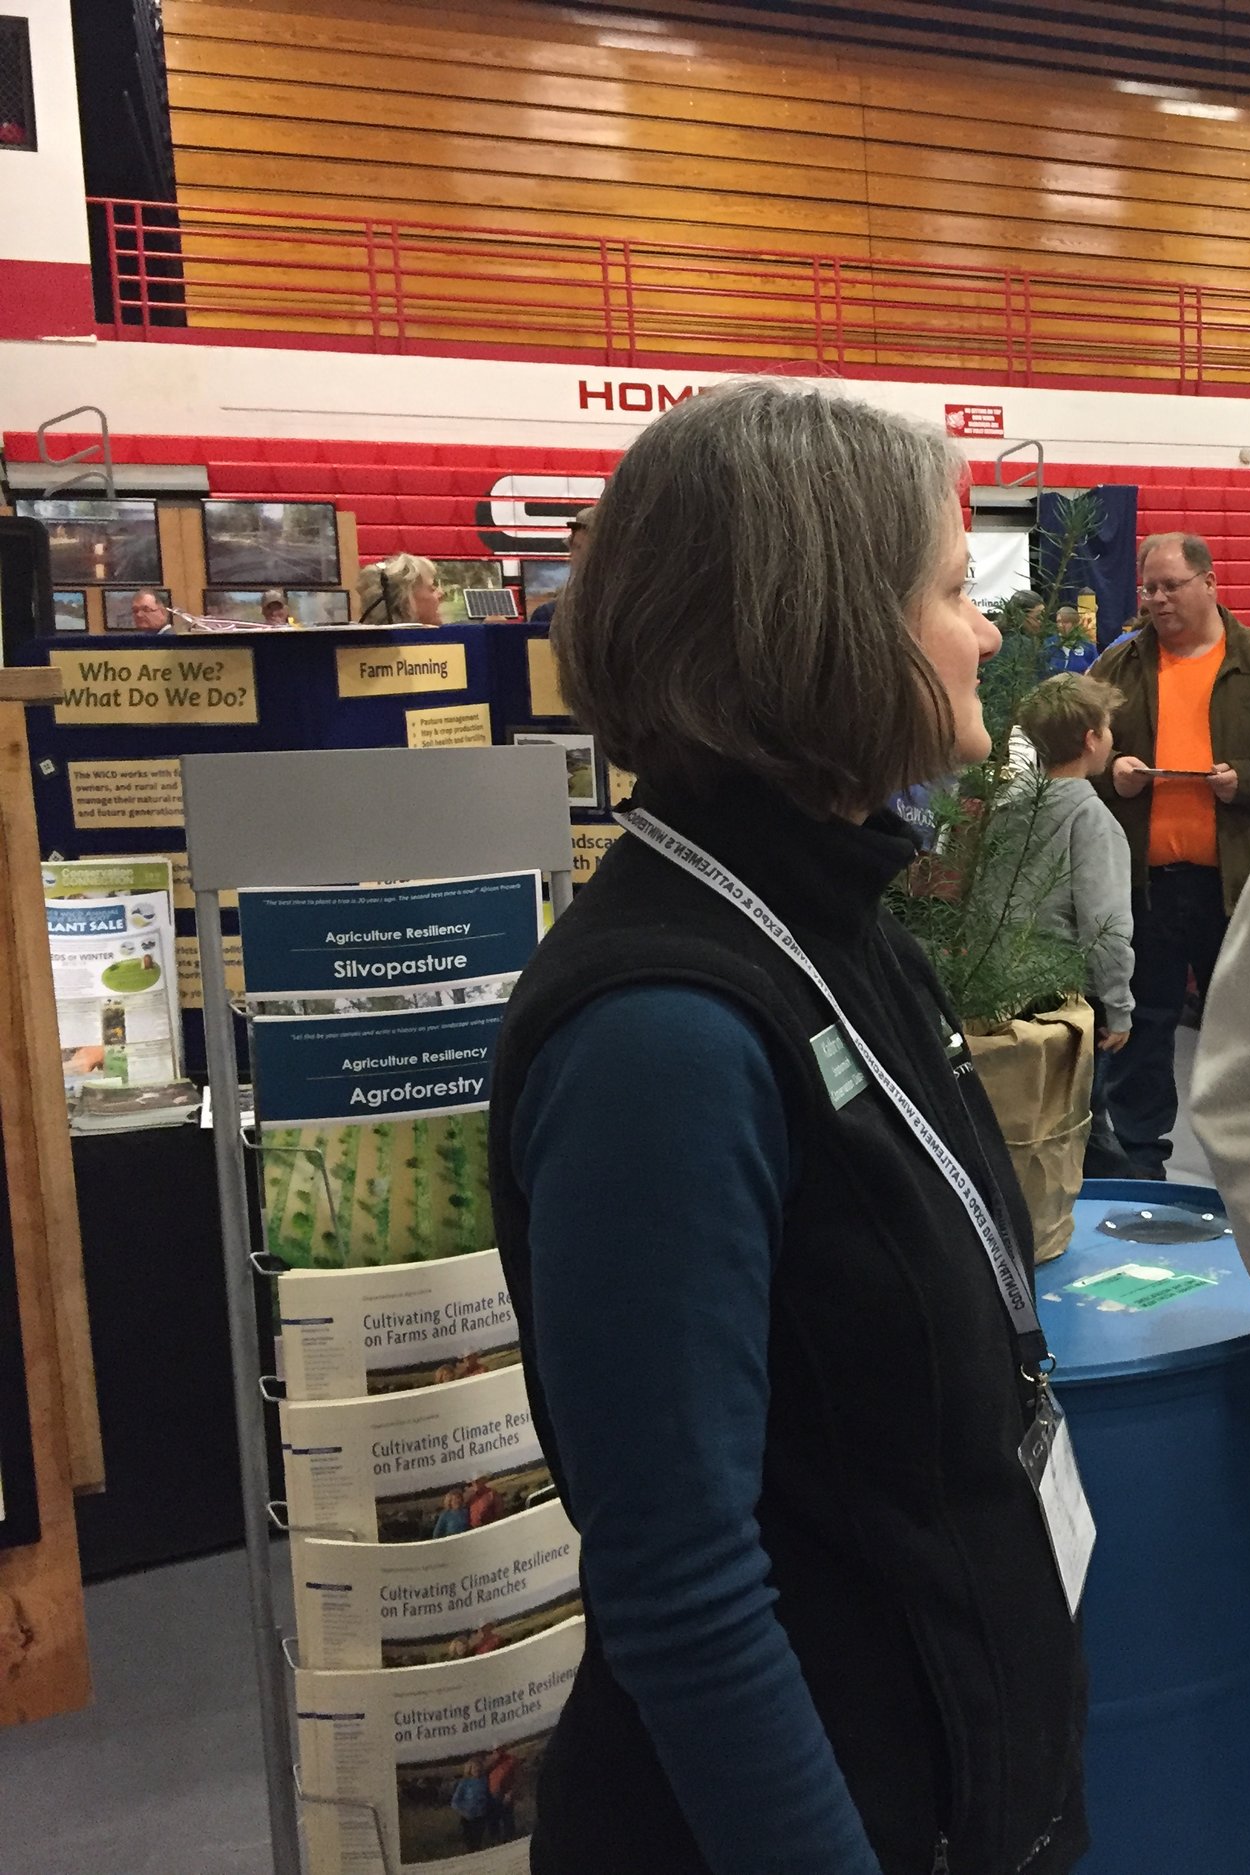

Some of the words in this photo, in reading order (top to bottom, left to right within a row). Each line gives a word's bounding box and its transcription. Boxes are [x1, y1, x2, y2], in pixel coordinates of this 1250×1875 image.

[578, 380, 708, 412] HOM
[78, 661, 132, 682] Who
[136, 664, 172, 682] Are
[177, 661, 225, 682] We?
[360, 661, 393, 679] Farm
[396, 658, 448, 679] Planning
[64, 687, 122, 708] What
[128, 687, 159, 708] Do
[165, 687, 202, 708] We
[207, 686, 247, 708] Do?
[89, 919, 124, 931] SALE
[325, 930, 402, 946] Agriculture
[406, 922, 471, 939] Resiliency
[79, 951, 114, 960] WINTER
[334, 952, 468, 979] Silvopasture
[342, 1054, 418, 1072] Agriculture
[422, 1046, 488, 1064] Resiliency
[350, 1076, 484, 1107] Agroforestry
[363, 1309, 440, 1330] Cultivating
[445, 1297, 494, 1319] Climate
[364, 1334, 382, 1347] on
[387, 1328, 428, 1345] Farms
[432, 1320, 457, 1339] and
[461, 1309, 511, 1333] Ranches
[371, 1434, 449, 1458] Cultivating
[452, 1420, 501, 1443] Climate
[373, 1461, 391, 1475] on
[395, 1454, 436, 1472] Farms
[440, 1445, 465, 1464] and
[470, 1432, 520, 1457] Ranches
[380, 1581, 456, 1601] Cultivating
[461, 1566, 510, 1592] Climate
[513, 1543, 570, 1575] Resilience
[380, 1605, 398, 1618] on
[403, 1600, 443, 1617] Farms
[448, 1591, 473, 1611] and
[477, 1577, 526, 1603] Ranches
[394, 1705, 471, 1726] Cultivating
[474, 1688, 525, 1713] Climate
[395, 1729, 412, 1743] on
[416, 1724, 457, 1740] Farms
[461, 1714, 486, 1734] and
[491, 1699, 542, 1726] Ranches
